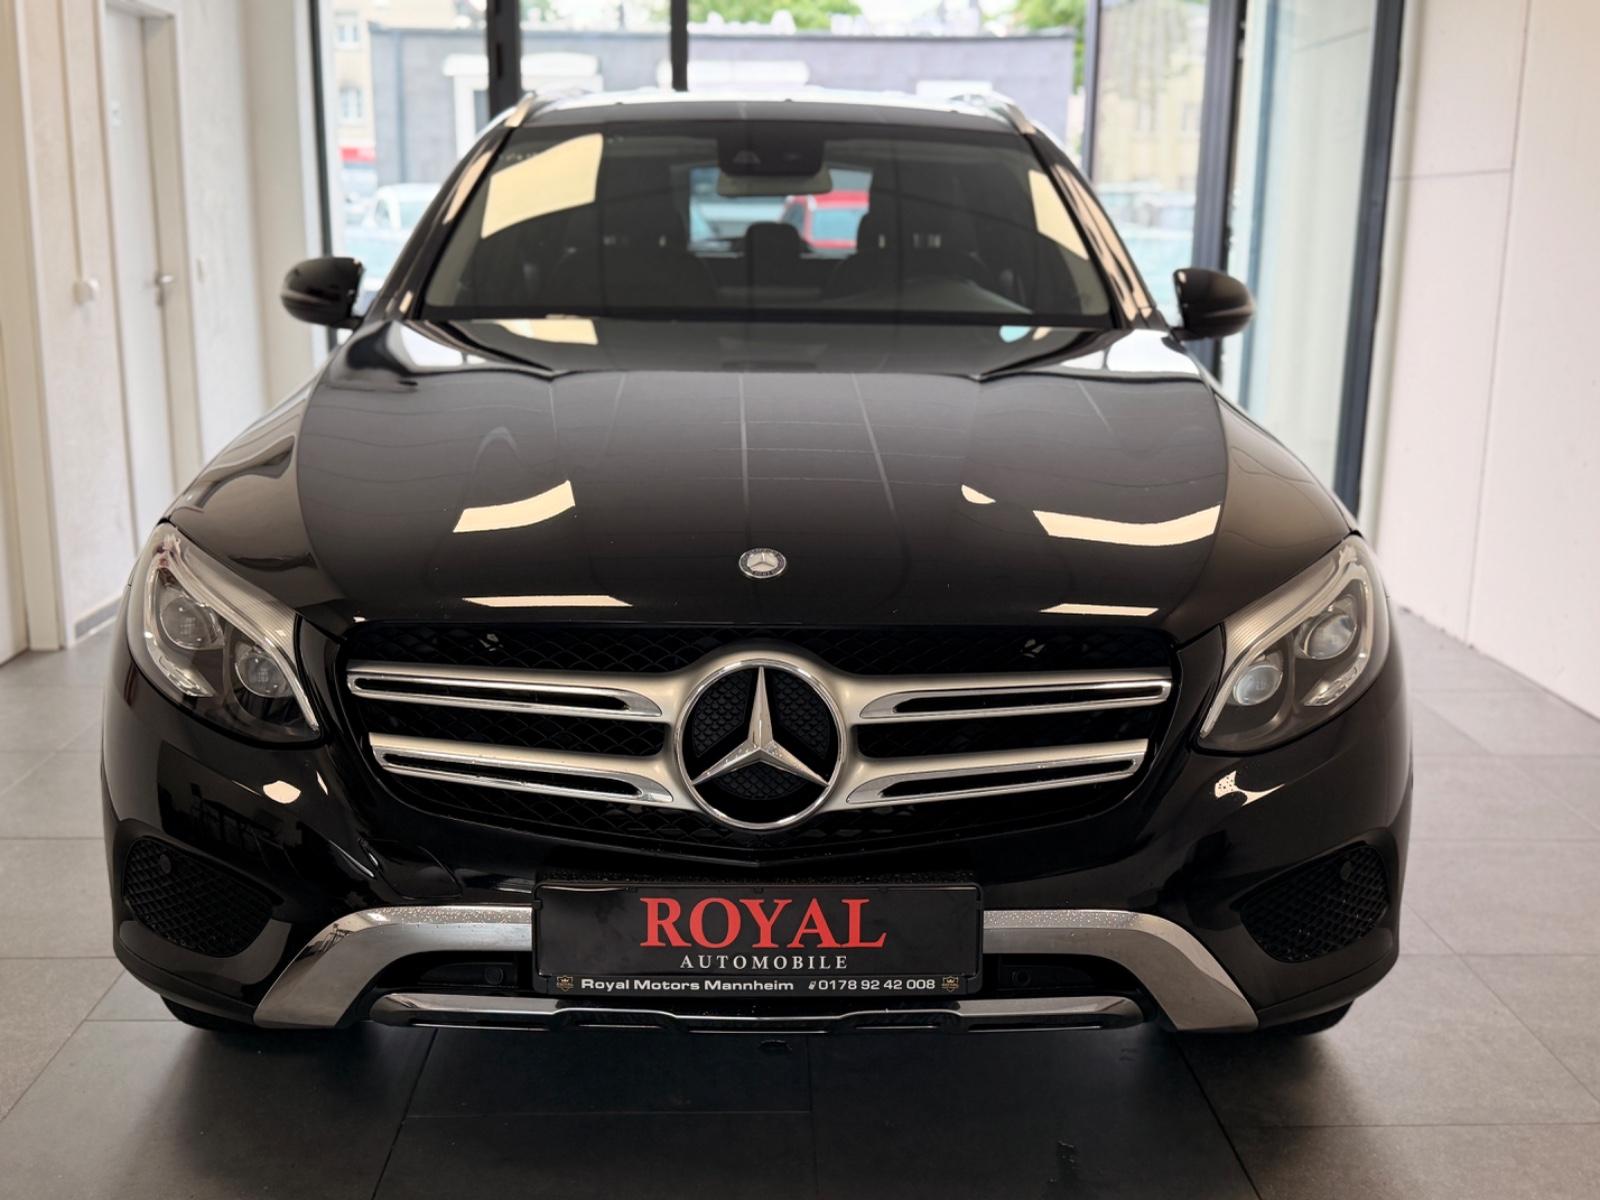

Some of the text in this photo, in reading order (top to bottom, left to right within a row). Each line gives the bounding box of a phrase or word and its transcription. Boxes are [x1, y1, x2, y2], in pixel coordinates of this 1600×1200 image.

[639, 897, 888, 948] ROYAL
[680, 955, 848, 970] AUTOMOBILE
[581, 978, 630, 992] Royal
[634, 979, 700, 991] Motors
[705, 979, 794, 991] Mannheim
[818, 979, 857, 991] 0178
[860, 979, 880, 991] 92
[883, 979, 903, 991] 42
[906, 979, 936, 990] 008
